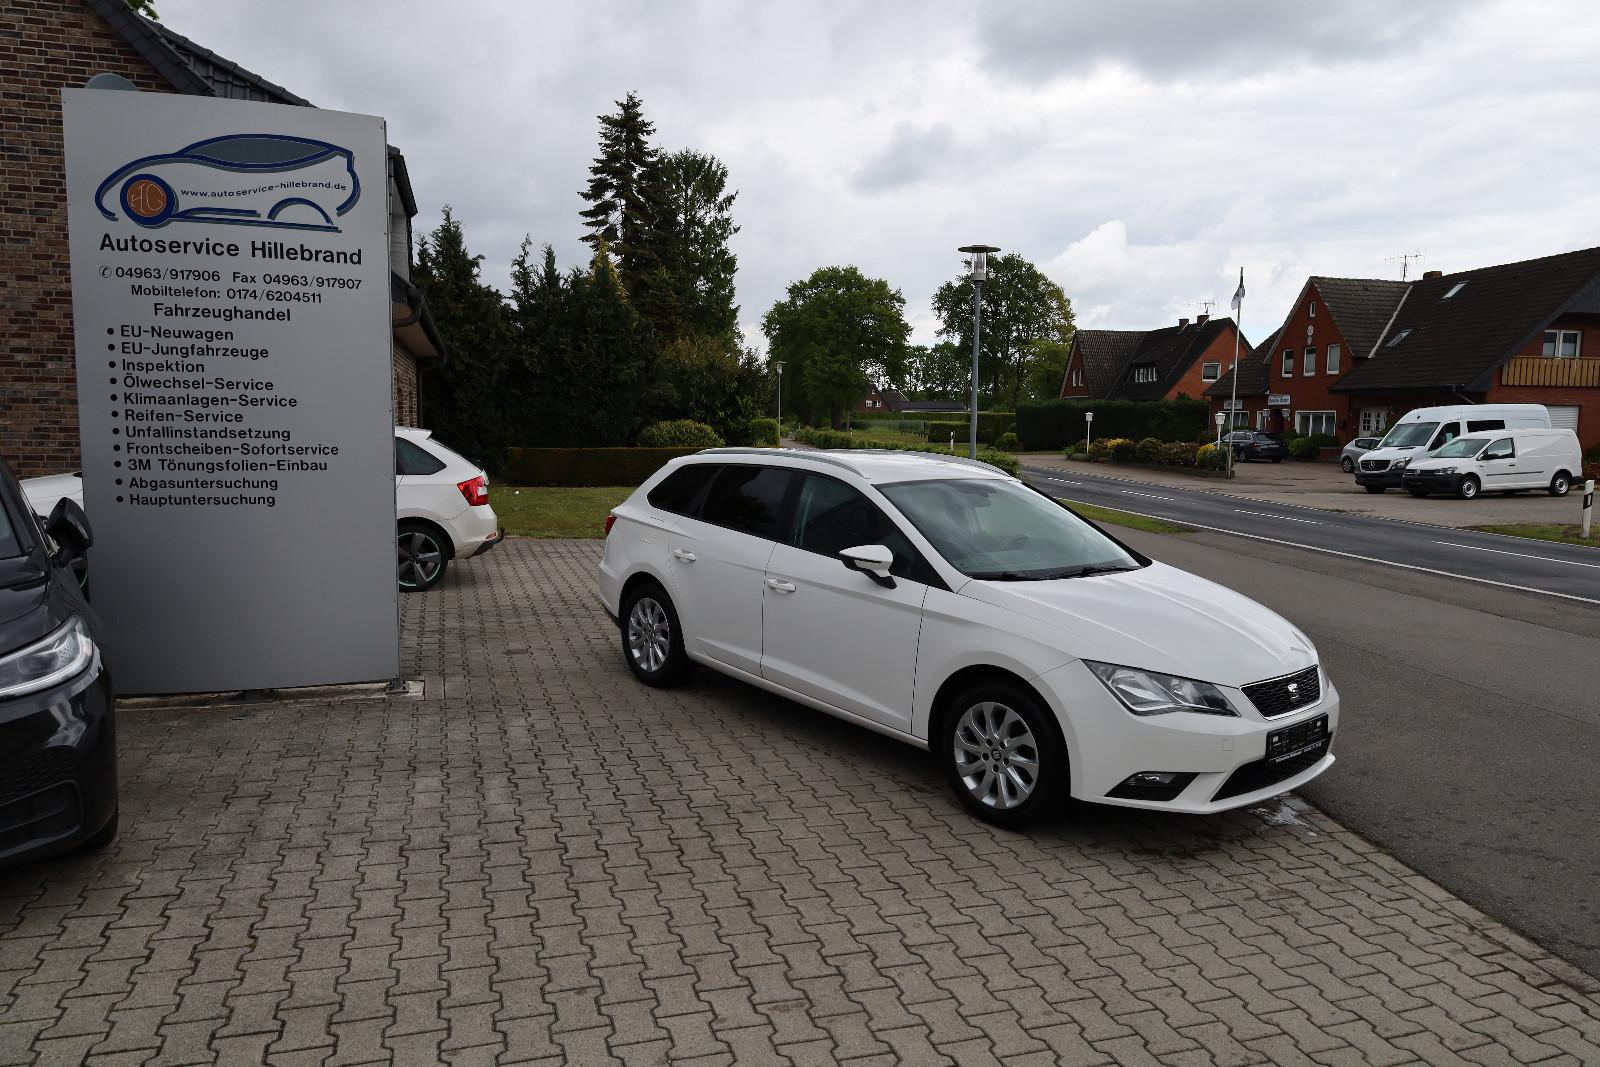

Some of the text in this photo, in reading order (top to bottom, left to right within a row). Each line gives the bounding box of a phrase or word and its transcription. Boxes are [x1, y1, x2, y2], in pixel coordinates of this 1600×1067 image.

[181, 180, 347, 198] www.autoservice-hillebrand.de
[100, 232, 362, 266] Autoservice Hillebrand
[115, 266, 362, 291] 04963/917906 Fax 04963/917907
[131, 285, 322, 304] Mobiltelefon: 0174/6204511
[154, 303, 291, 322] Fahrzeughandel
[120, 325, 234, 341] EU-Neuwagen
[121, 342, 269, 360] EU-Jungfahrzeuge
[122, 358, 205, 374] Inspektion
[123, 373, 274, 391] Ölwechsel-Service
[124, 392, 297, 408] Klimaanlagen-Service
[125, 409, 244, 423] Reifen-Service
[125, 426, 291, 442] Unfallinstandsetzung
[126, 443, 339, 457] Frontscheiben-Sofortservice
[128, 458, 328, 474] 3M Tönungsfolien-Einbau
[129, 477, 279, 492] Abgasuntersuchung
[129, 494, 276, 508] Hauptuntersuchung
